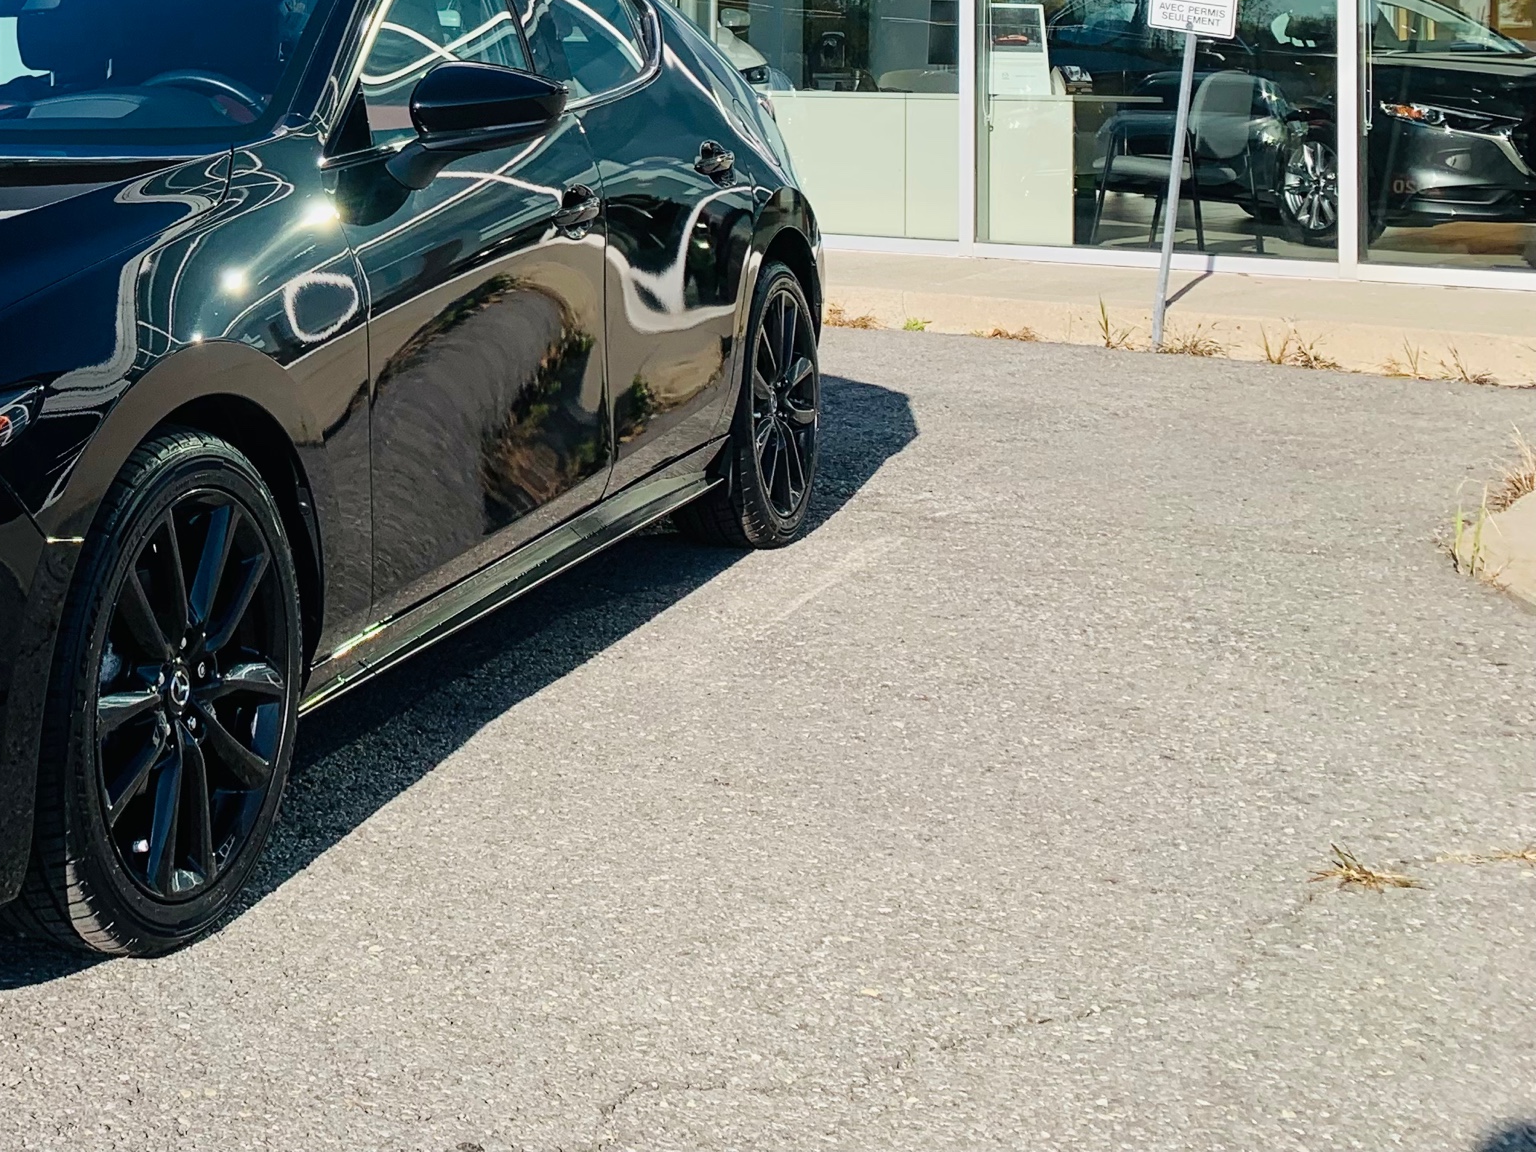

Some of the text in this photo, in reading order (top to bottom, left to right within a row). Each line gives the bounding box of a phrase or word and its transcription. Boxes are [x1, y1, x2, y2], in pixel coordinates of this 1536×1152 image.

[1159, 2, 1226, 18] AVEC PERMIS
[1162, 11, 1221, 27] SEULEMENT
